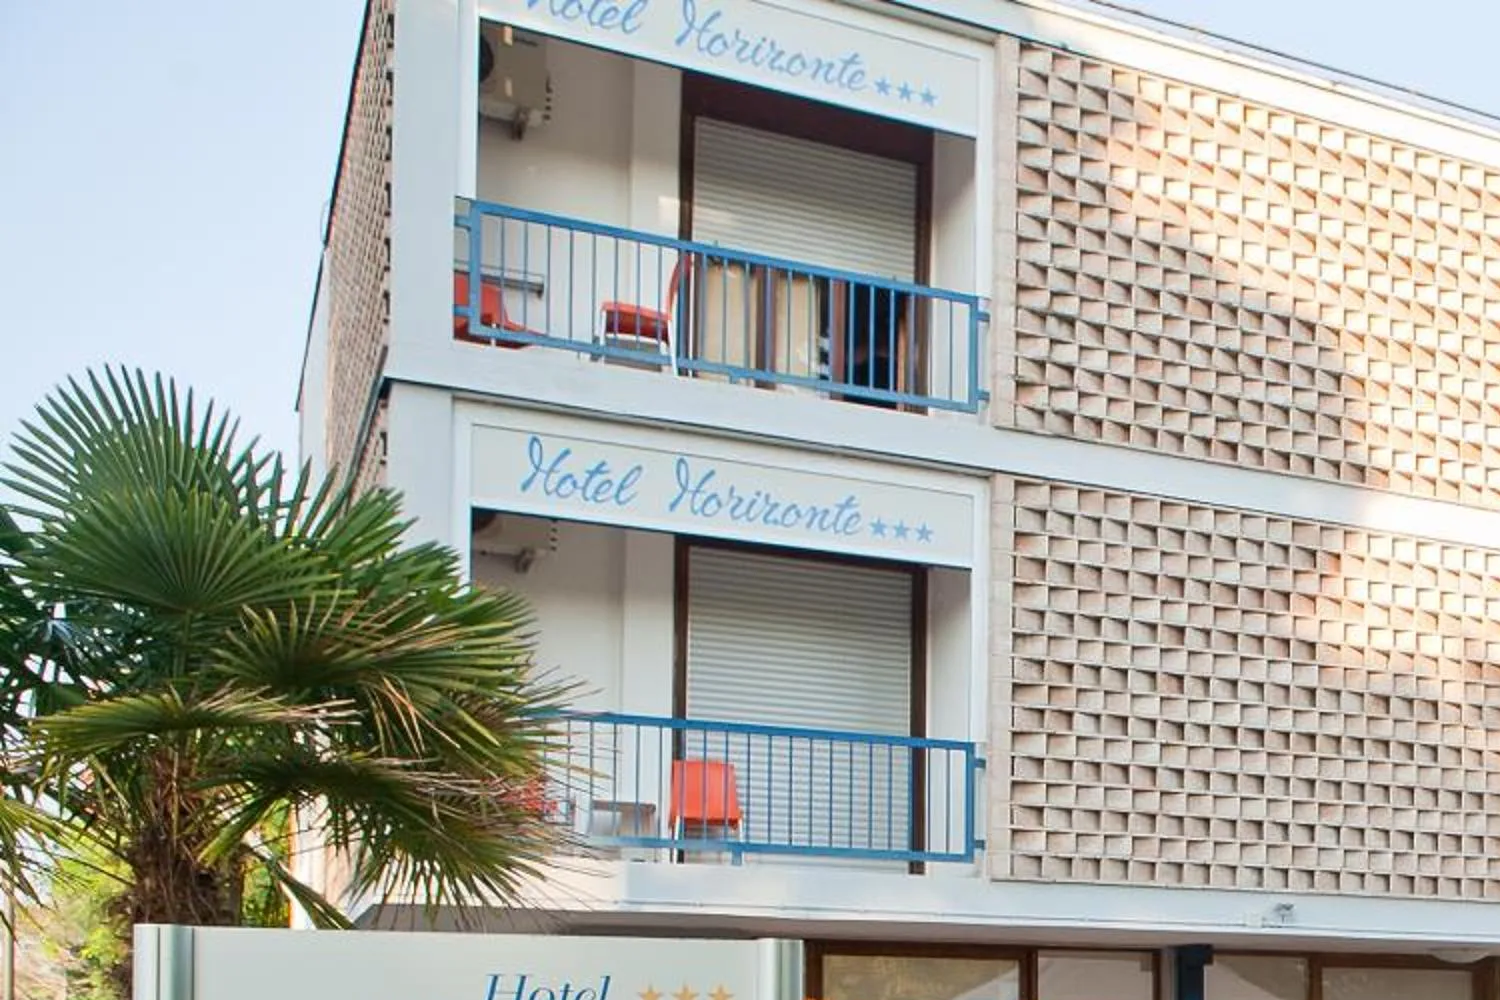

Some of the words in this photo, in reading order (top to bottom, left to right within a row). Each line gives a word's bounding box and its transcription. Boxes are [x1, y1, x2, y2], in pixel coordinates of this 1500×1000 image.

[527, 0, 646, 36] otel
[520, 435, 644, 507] Hotel
[668, 457, 862, 537] Horizonte
